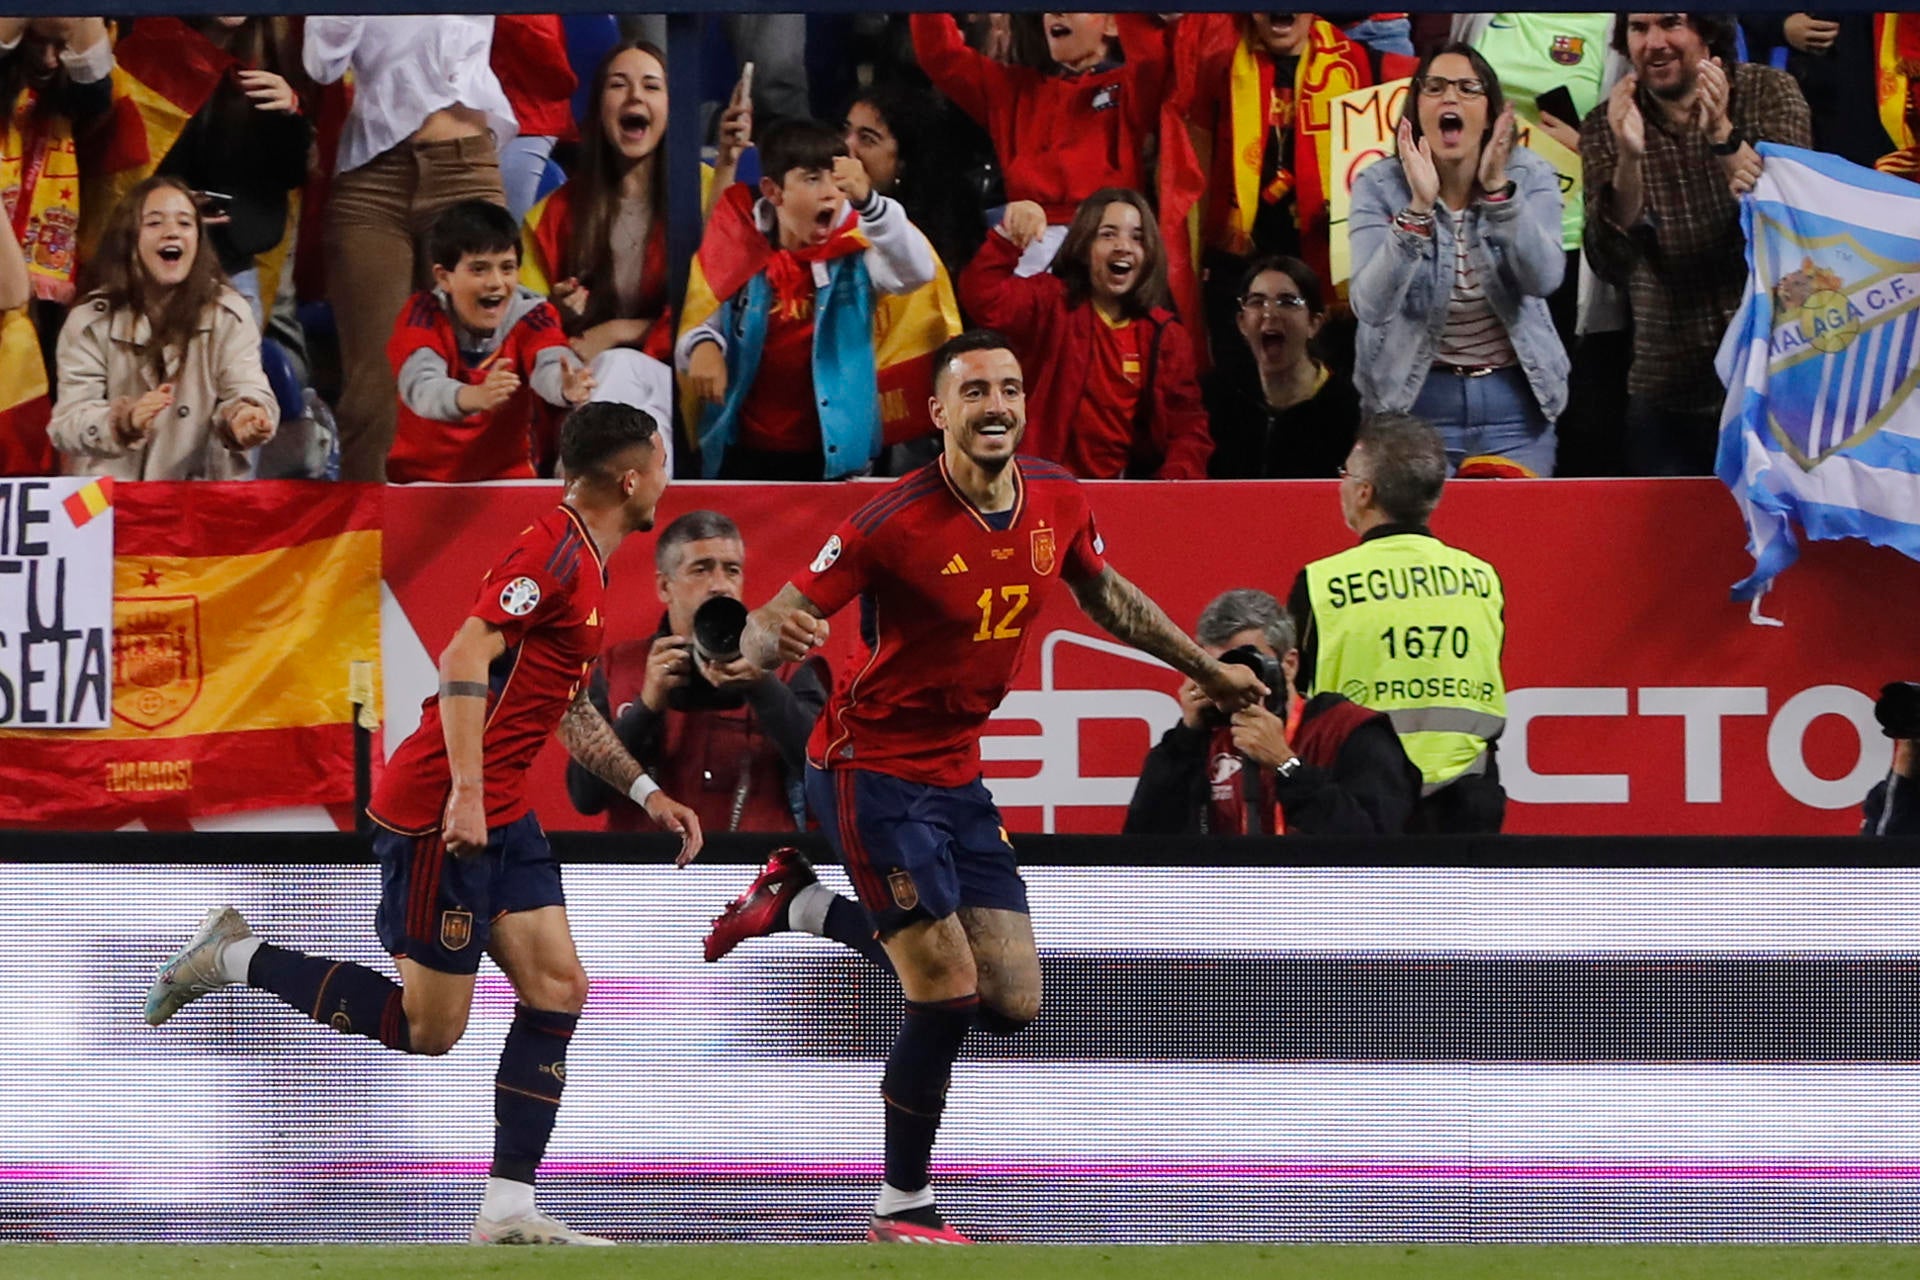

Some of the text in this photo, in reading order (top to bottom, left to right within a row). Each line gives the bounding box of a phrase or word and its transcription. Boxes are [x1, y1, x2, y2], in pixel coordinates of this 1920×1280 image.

[1328, 564, 1491, 609] SEGURIDAD
[973, 584, 1029, 642] 12
[1381, 625, 1469, 659] 1670
